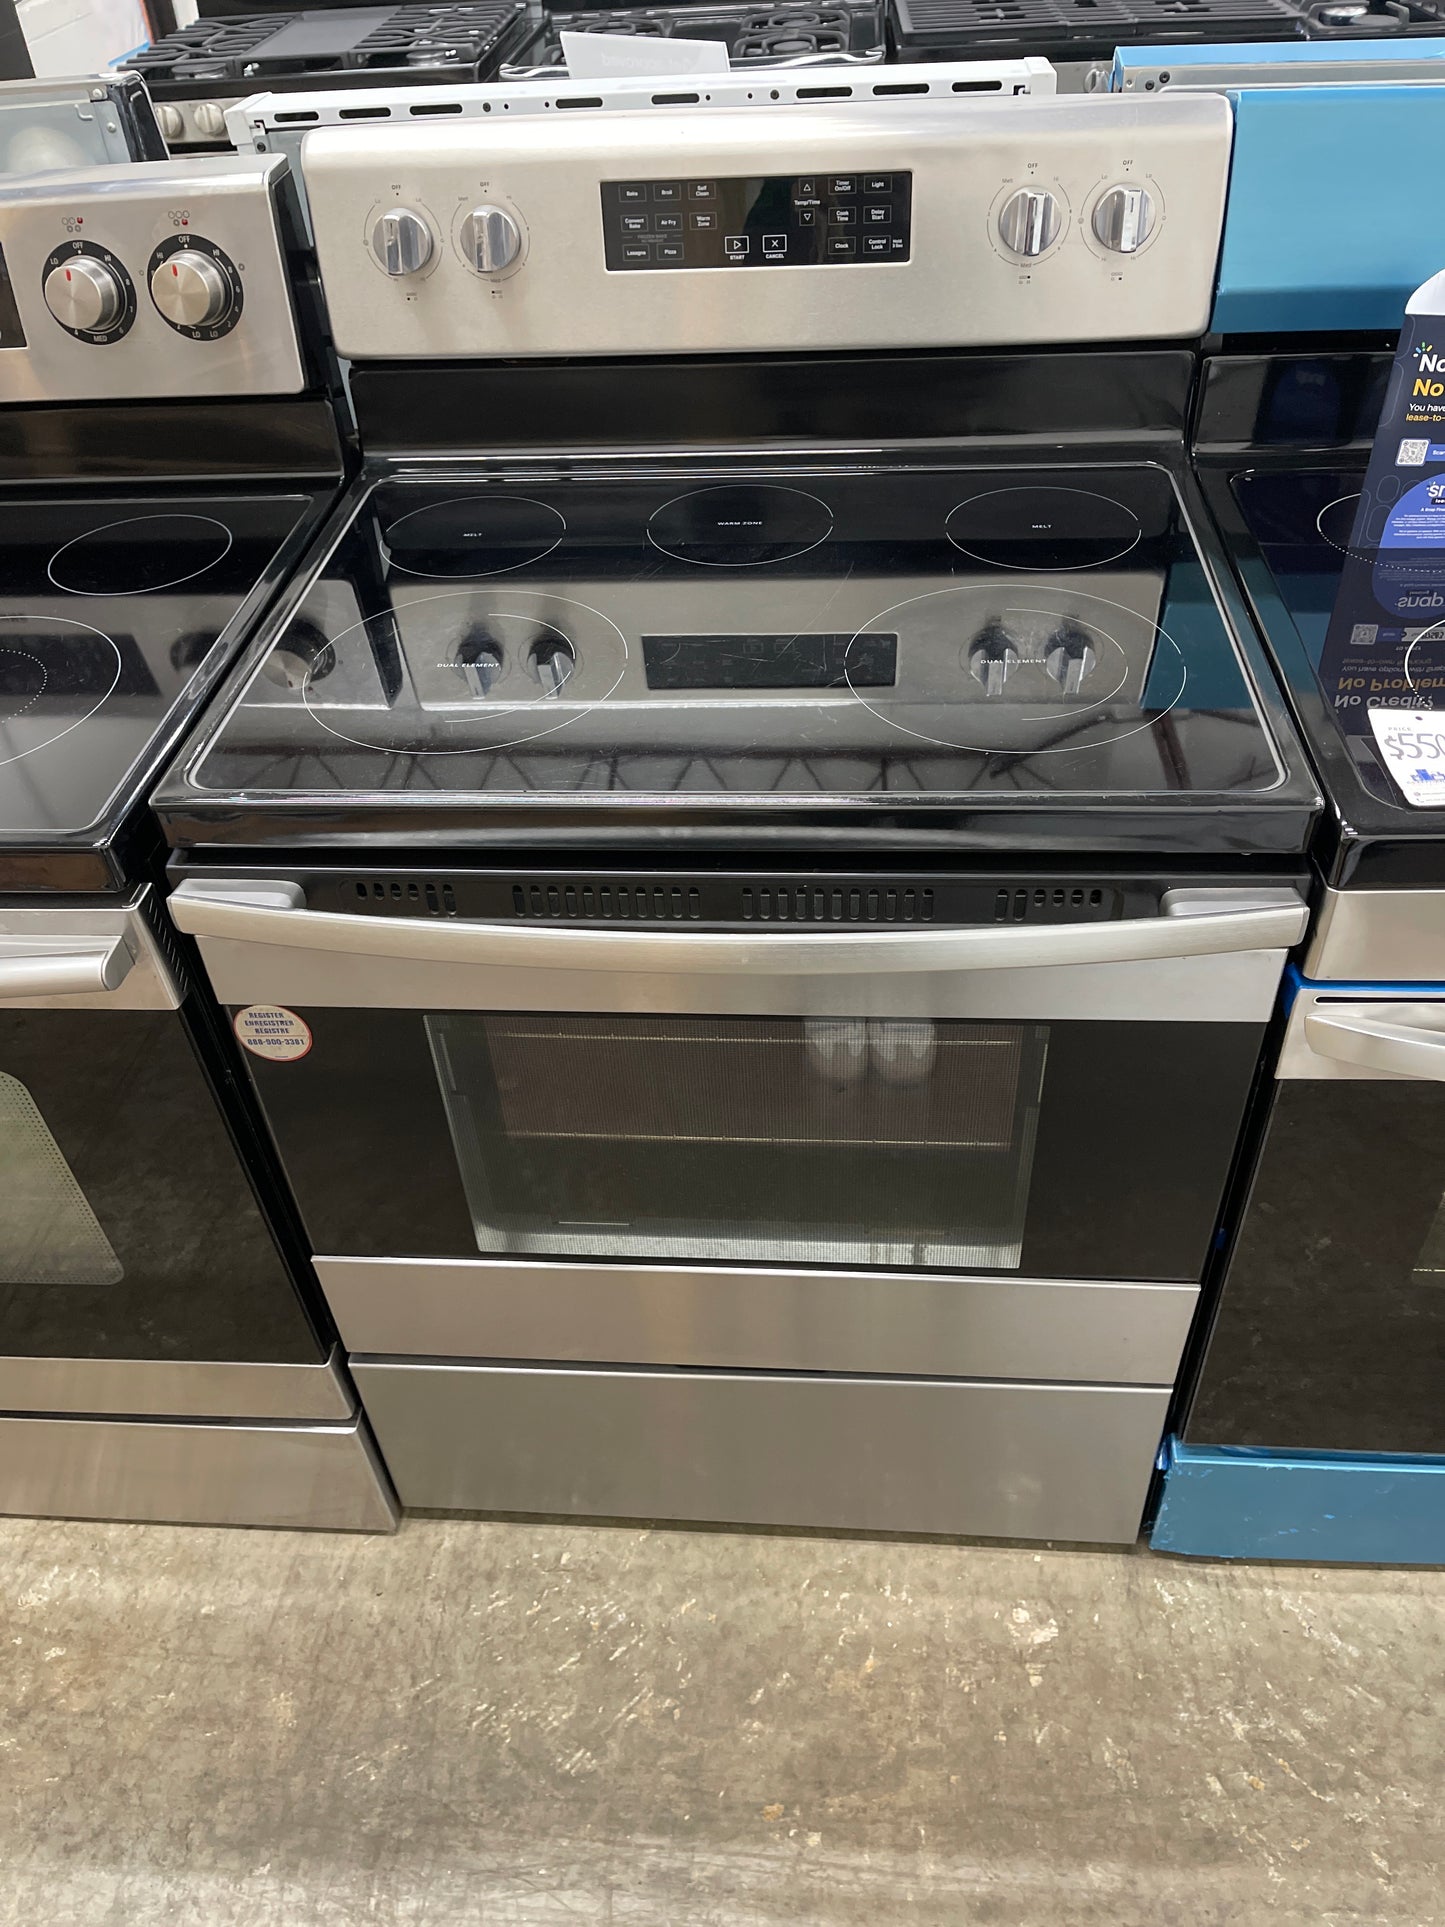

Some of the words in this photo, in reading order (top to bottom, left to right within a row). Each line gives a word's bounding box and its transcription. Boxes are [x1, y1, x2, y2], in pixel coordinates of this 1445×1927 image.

[104, 254, 112, 262] HI
[1419, 354, 1445, 373] No
[1412, 379, 1444, 397] No
[1409, 403, 1426, 412] You
